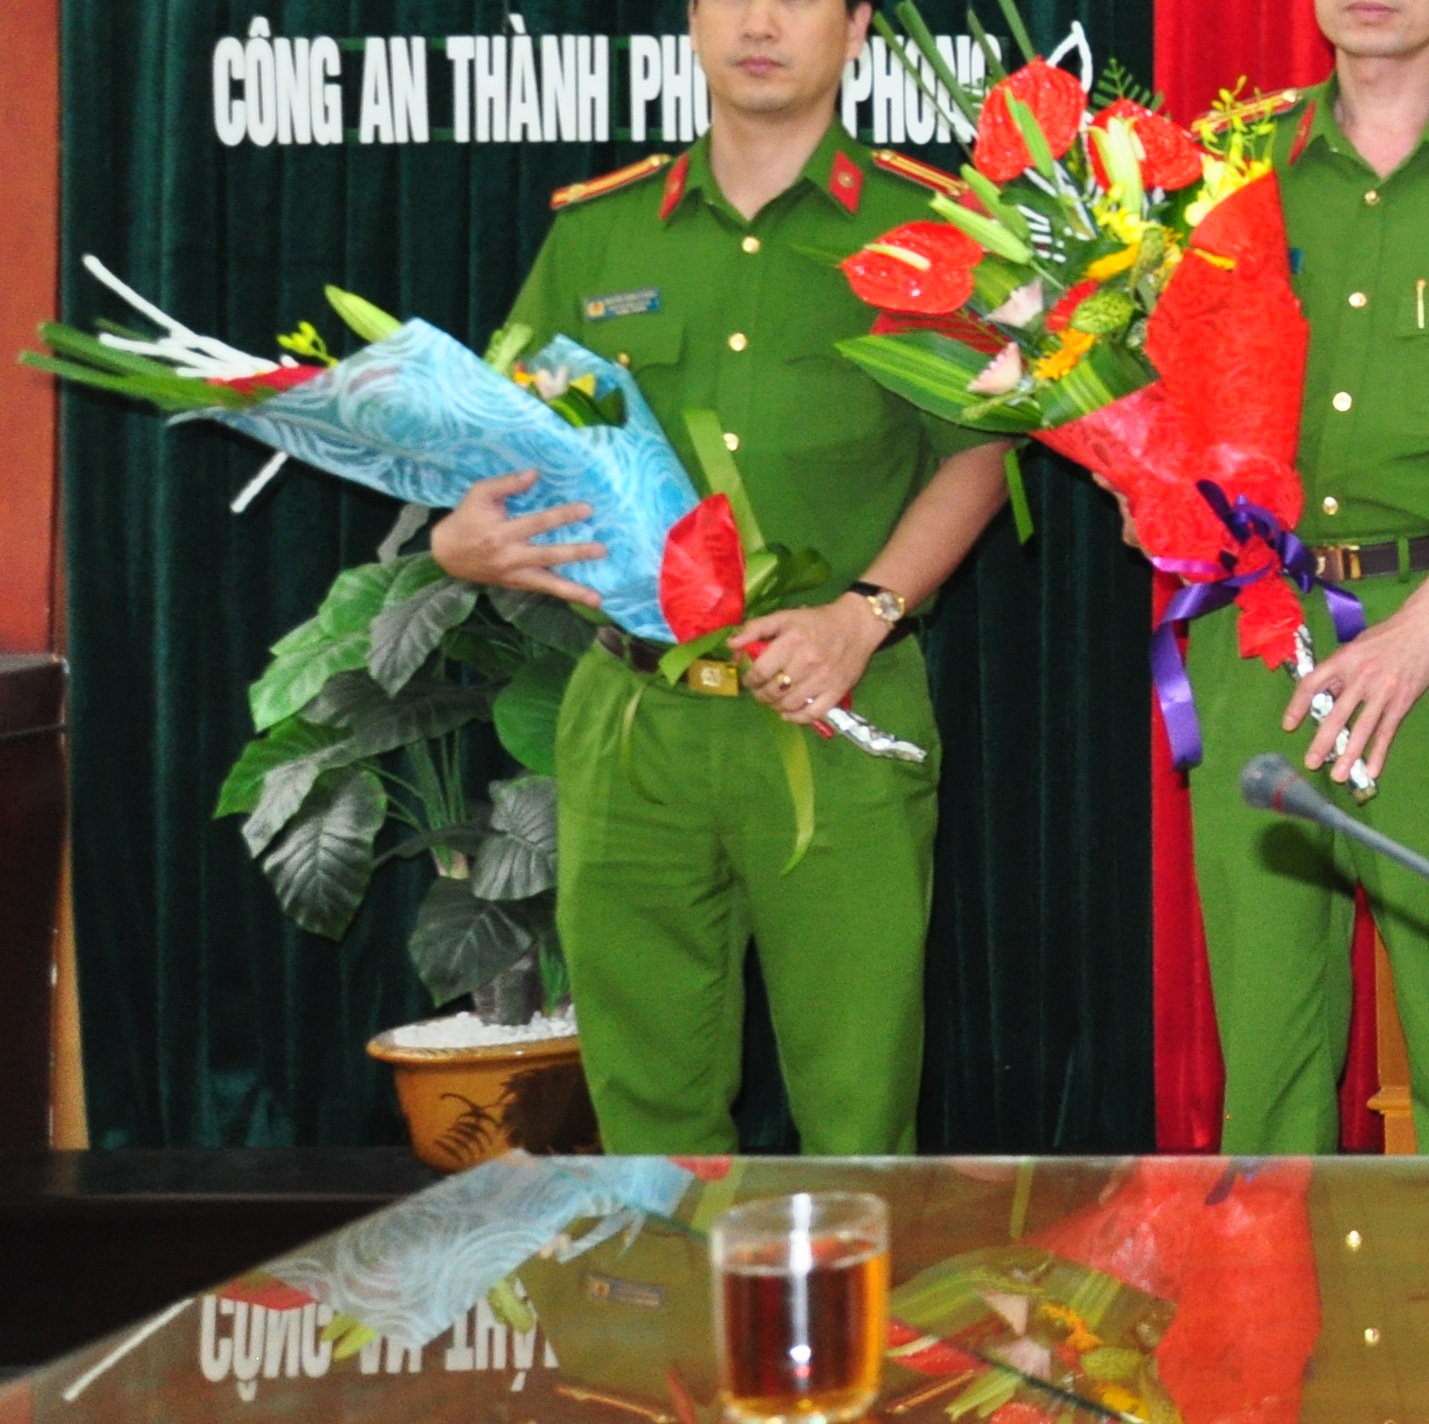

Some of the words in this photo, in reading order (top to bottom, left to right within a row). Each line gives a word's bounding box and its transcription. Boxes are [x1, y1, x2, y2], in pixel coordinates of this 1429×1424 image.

[213, 16, 343, 147] CÔNG
[358, 35, 429, 144] AN
[445, 13, 609, 143] THÀNH
